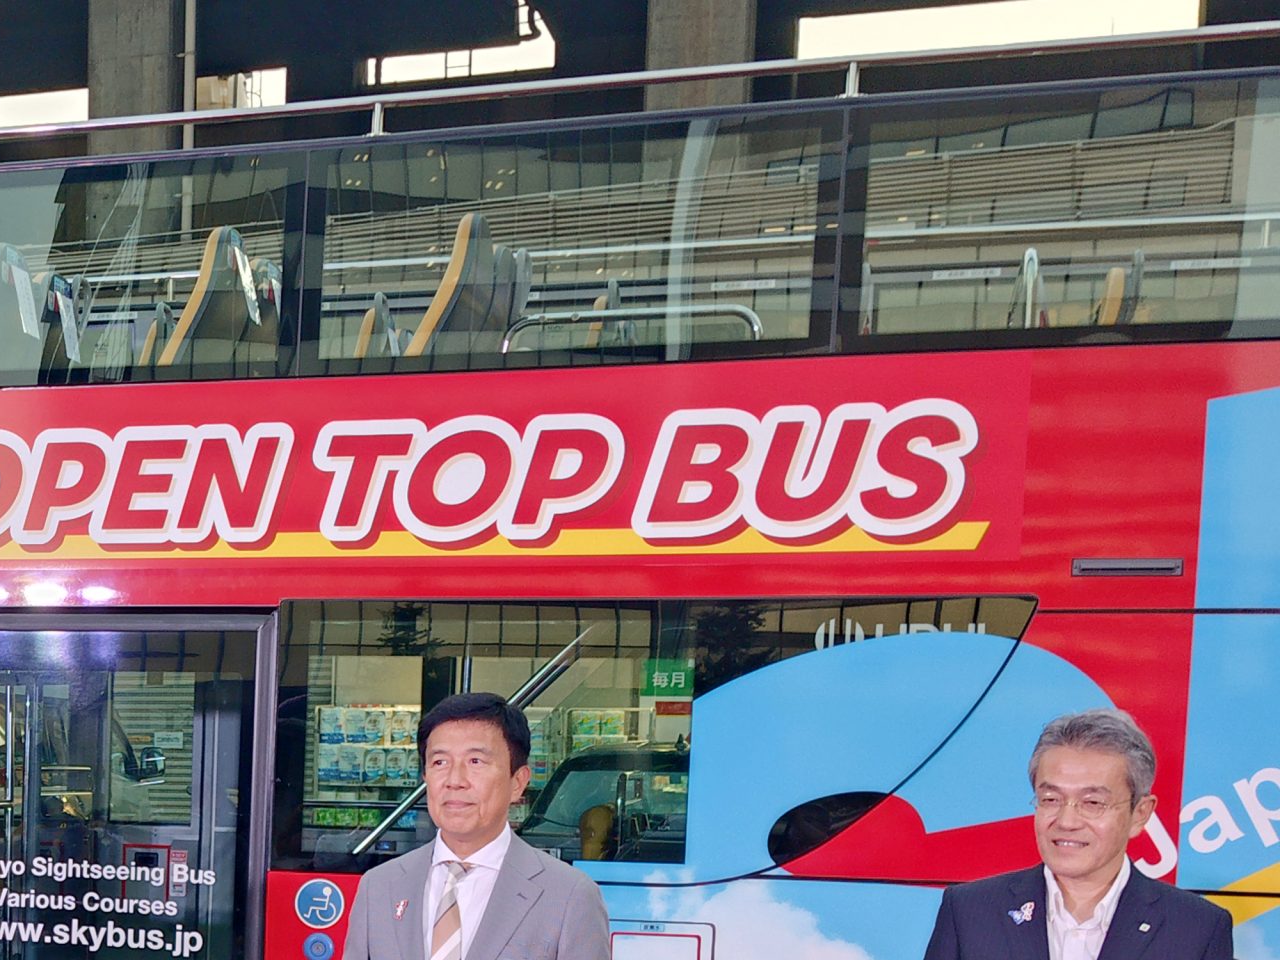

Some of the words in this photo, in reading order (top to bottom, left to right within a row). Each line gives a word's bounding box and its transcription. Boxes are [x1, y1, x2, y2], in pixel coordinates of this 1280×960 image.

[315, 413, 624, 542] TOP
[632, 399, 978, 540] BUS
[651, 671, 686, 689] 毎月
[31, 856, 166, 887] Sightseeing
[172, 863, 217, 886] Bus
[82, 891, 179, 916] Courses
